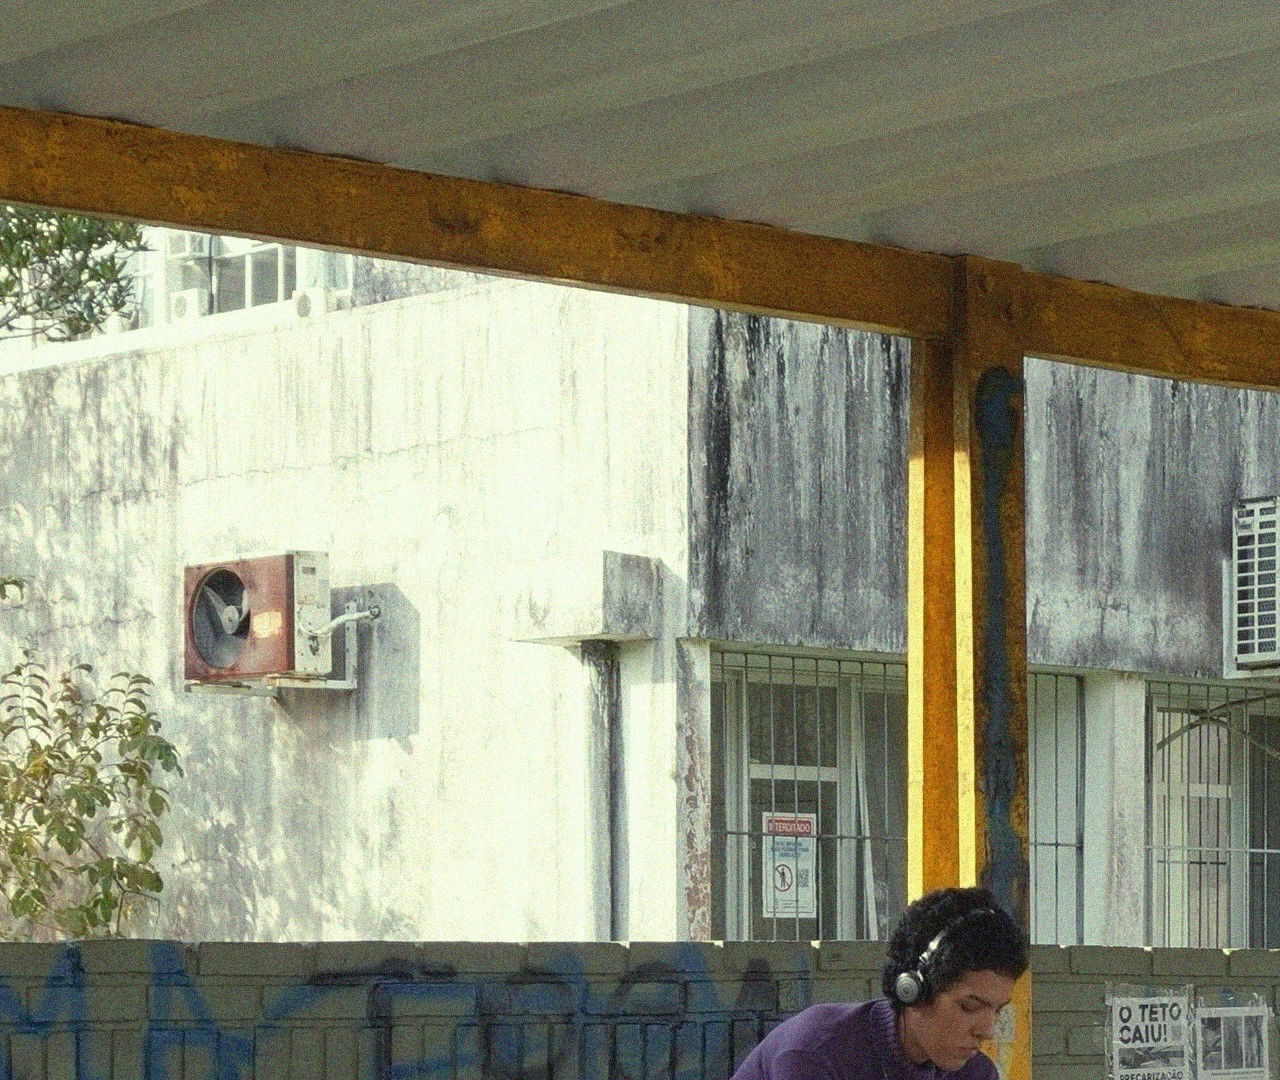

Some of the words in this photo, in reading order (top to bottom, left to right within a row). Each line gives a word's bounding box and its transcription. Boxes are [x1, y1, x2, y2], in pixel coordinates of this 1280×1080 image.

[1119, 1006, 1132, 1023] O
[1139, 1002, 1181, 1022] TETO
[1119, 1025, 1167, 1044] CAIU!
